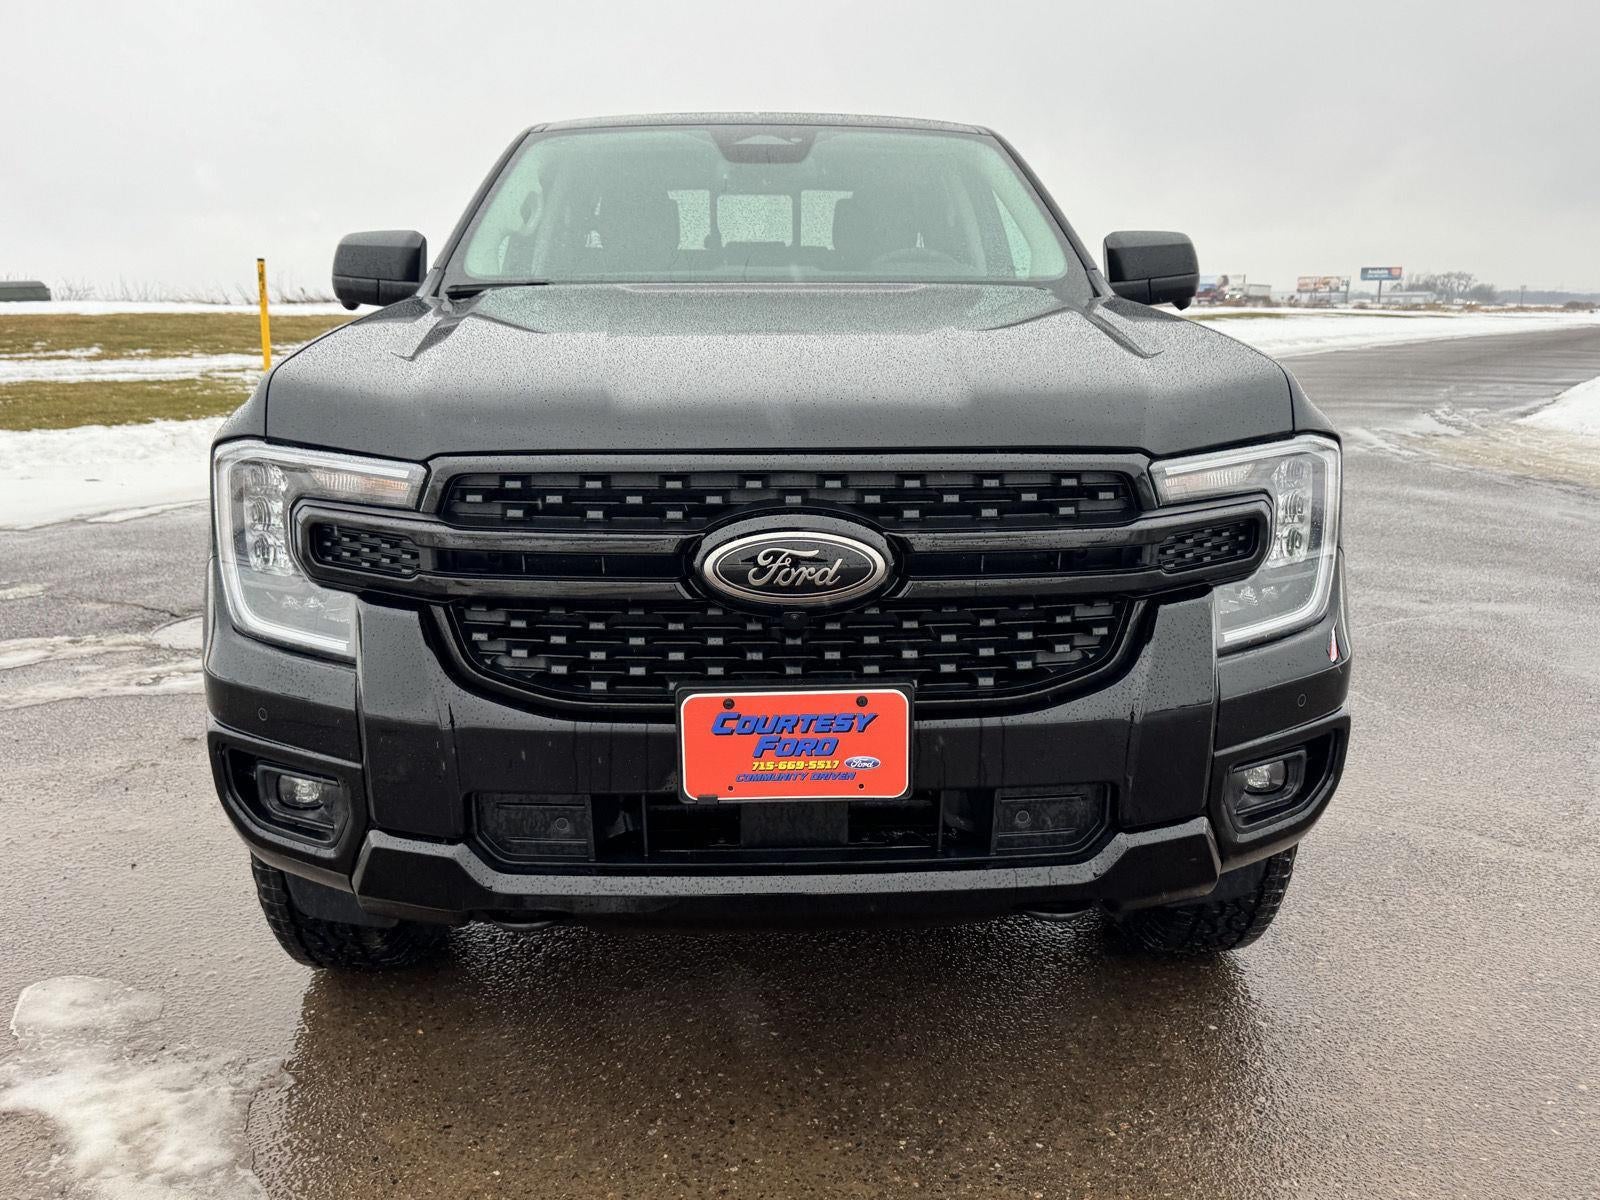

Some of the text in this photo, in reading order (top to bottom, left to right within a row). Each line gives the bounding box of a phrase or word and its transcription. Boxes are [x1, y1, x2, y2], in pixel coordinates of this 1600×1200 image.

[748, 548, 843, 586] Ford
[711, 712, 877, 735] COURTESY
[753, 736, 839, 758] FORD
[751, 760, 840, 771] 715-669-5517
[849, 760, 875, 769] Ford
[735, 771, 857, 783] COMMUNITY DRIVEN
